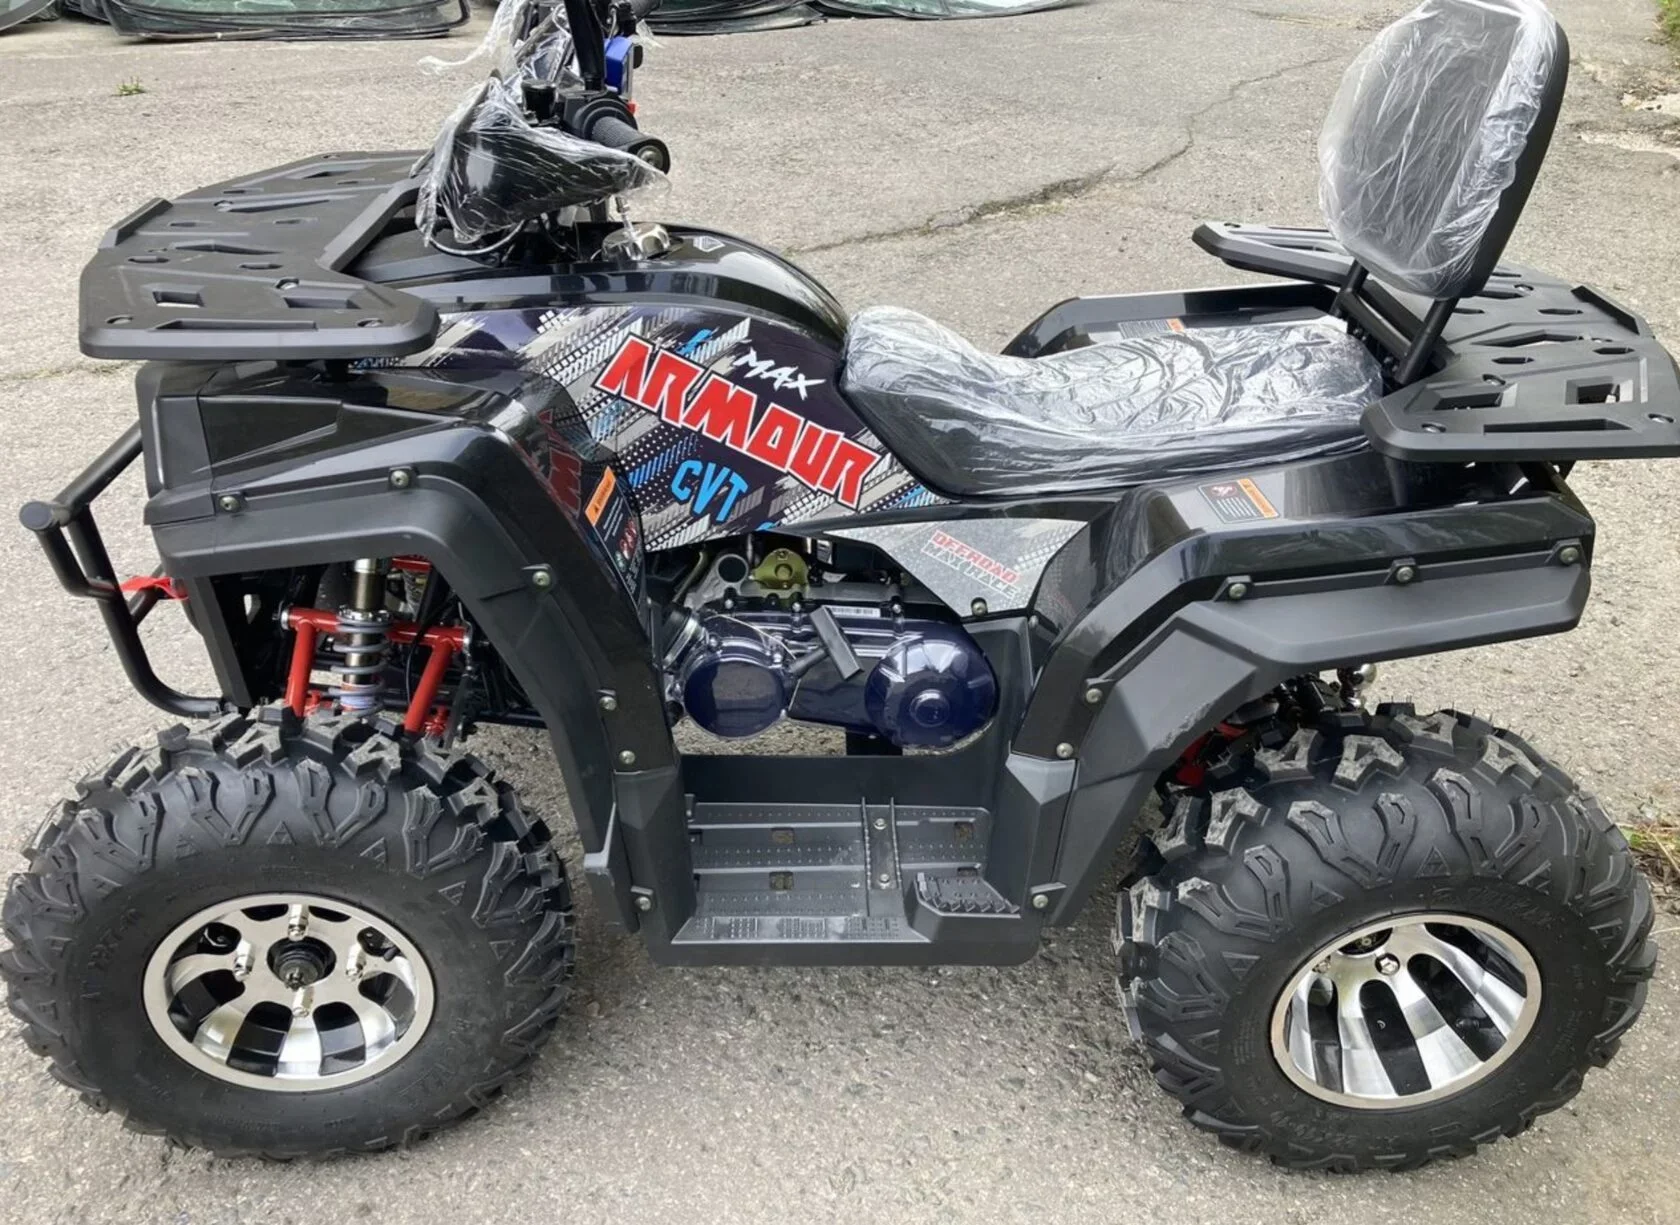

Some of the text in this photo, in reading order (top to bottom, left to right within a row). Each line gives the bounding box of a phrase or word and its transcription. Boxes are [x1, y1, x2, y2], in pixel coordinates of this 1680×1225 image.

[734, 347, 826, 400] MAX
[595, 334, 884, 509] ARMOUR
[670, 459, 749, 522] CVT
[929, 529, 1021, 584] OFFROAD
